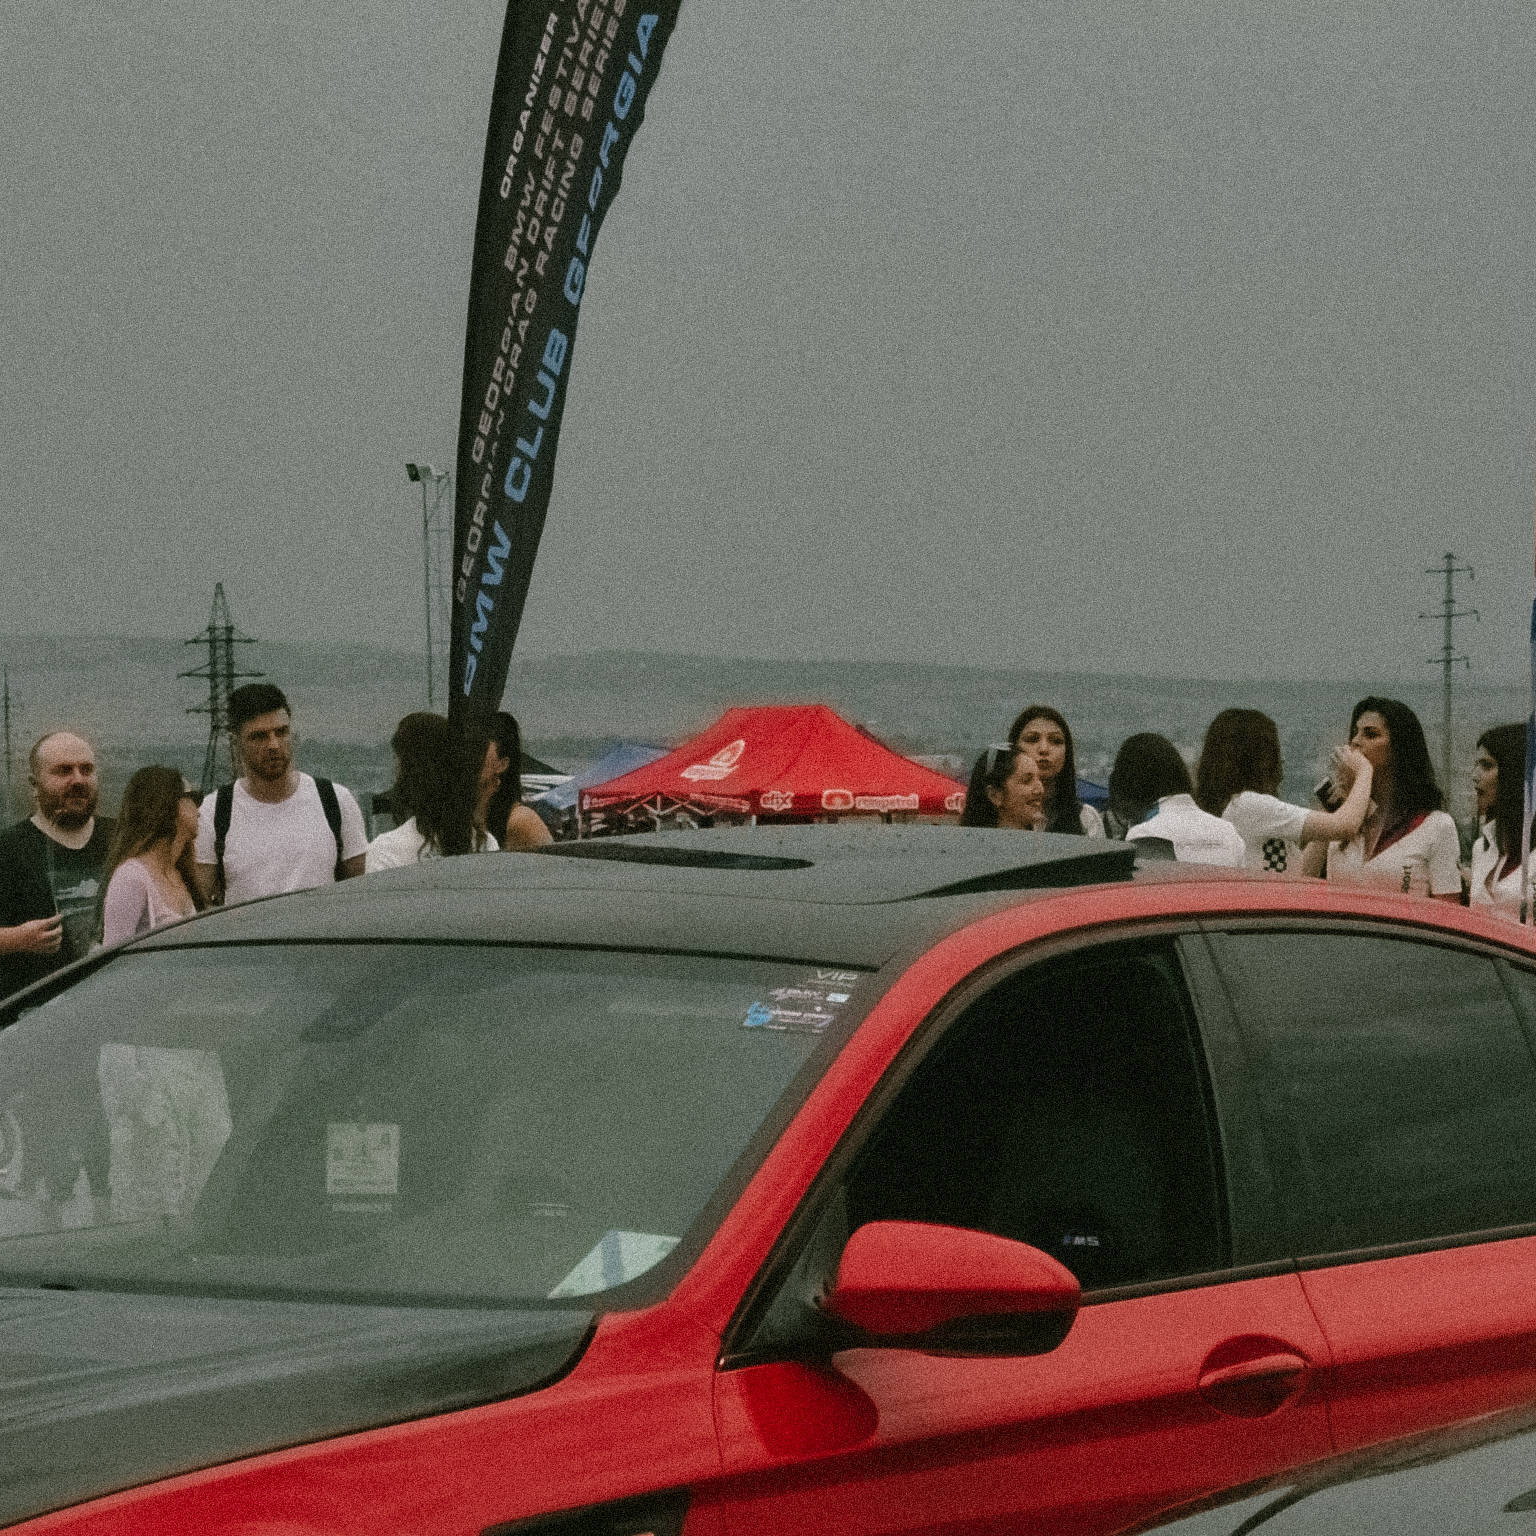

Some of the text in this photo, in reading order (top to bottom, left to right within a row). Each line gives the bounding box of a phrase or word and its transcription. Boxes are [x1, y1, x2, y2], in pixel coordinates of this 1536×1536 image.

[500, 12, 559, 199] ORGANIZER
[526, 128, 565, 246] DRIFT
[564, 0, 610, 118] SERIE
[503, 287, 538, 396] DRAG
[534, 133, 584, 276] RACING
[504, 170, 535, 272] BMW
[504, 330, 568, 503] CLUB
